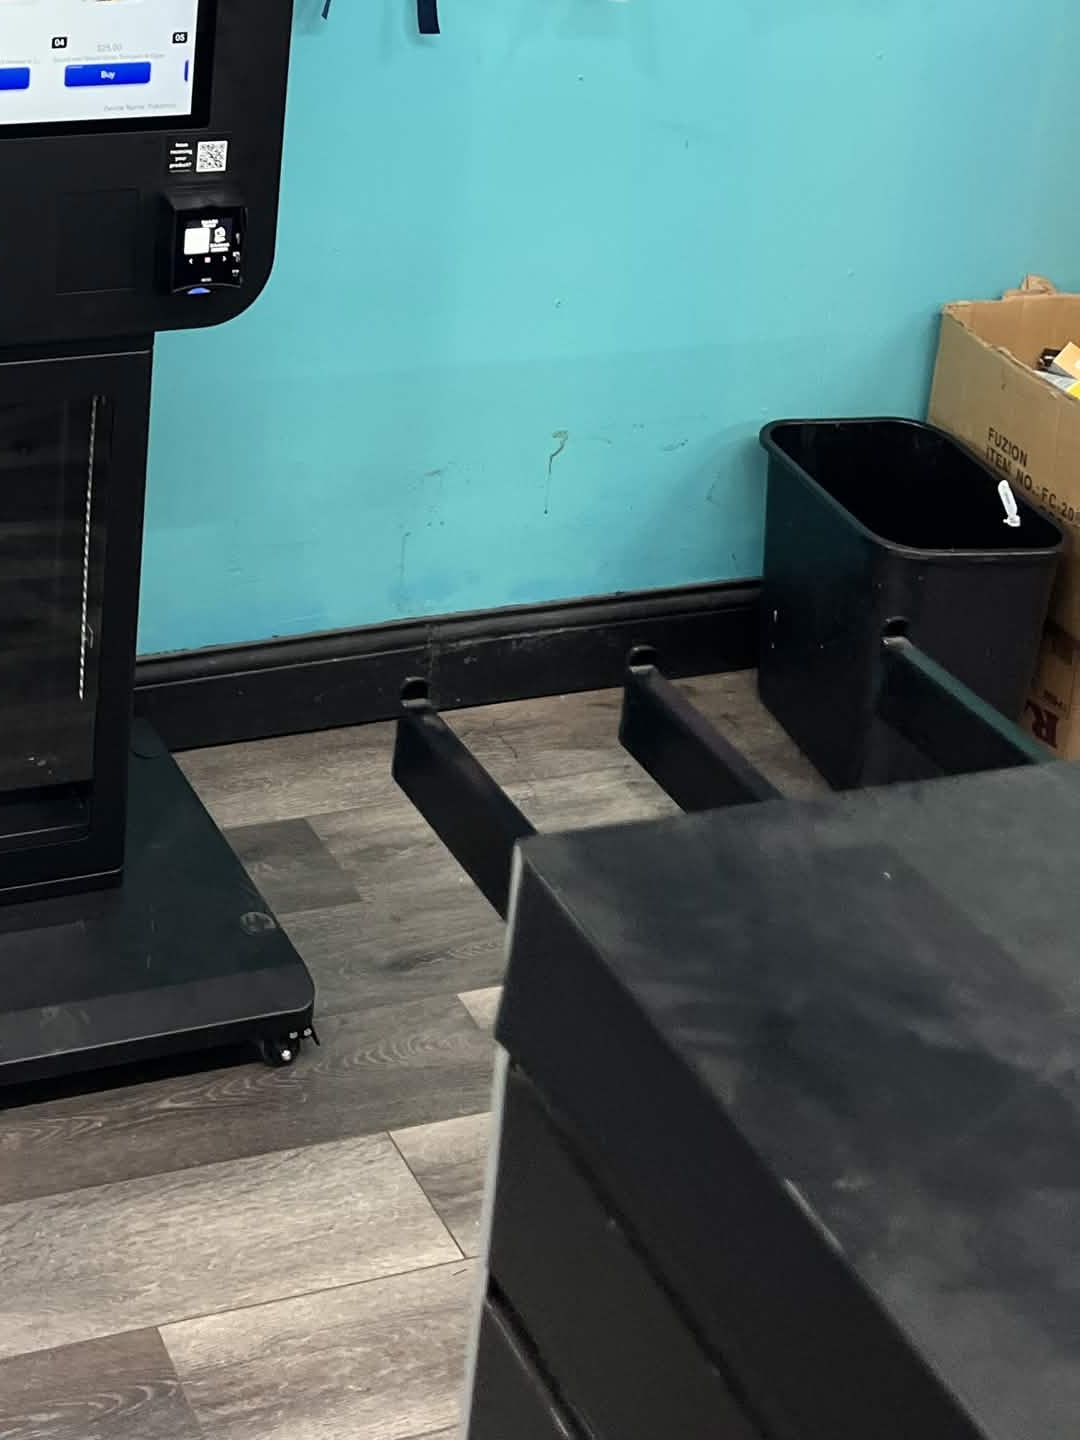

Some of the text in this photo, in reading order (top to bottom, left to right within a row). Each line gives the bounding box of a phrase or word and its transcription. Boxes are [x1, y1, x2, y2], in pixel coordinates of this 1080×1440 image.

[100, 70, 116, 80] Buy
[985, 445, 1012, 474] ITEM
[987, 427, 1028, 467] FUZION
